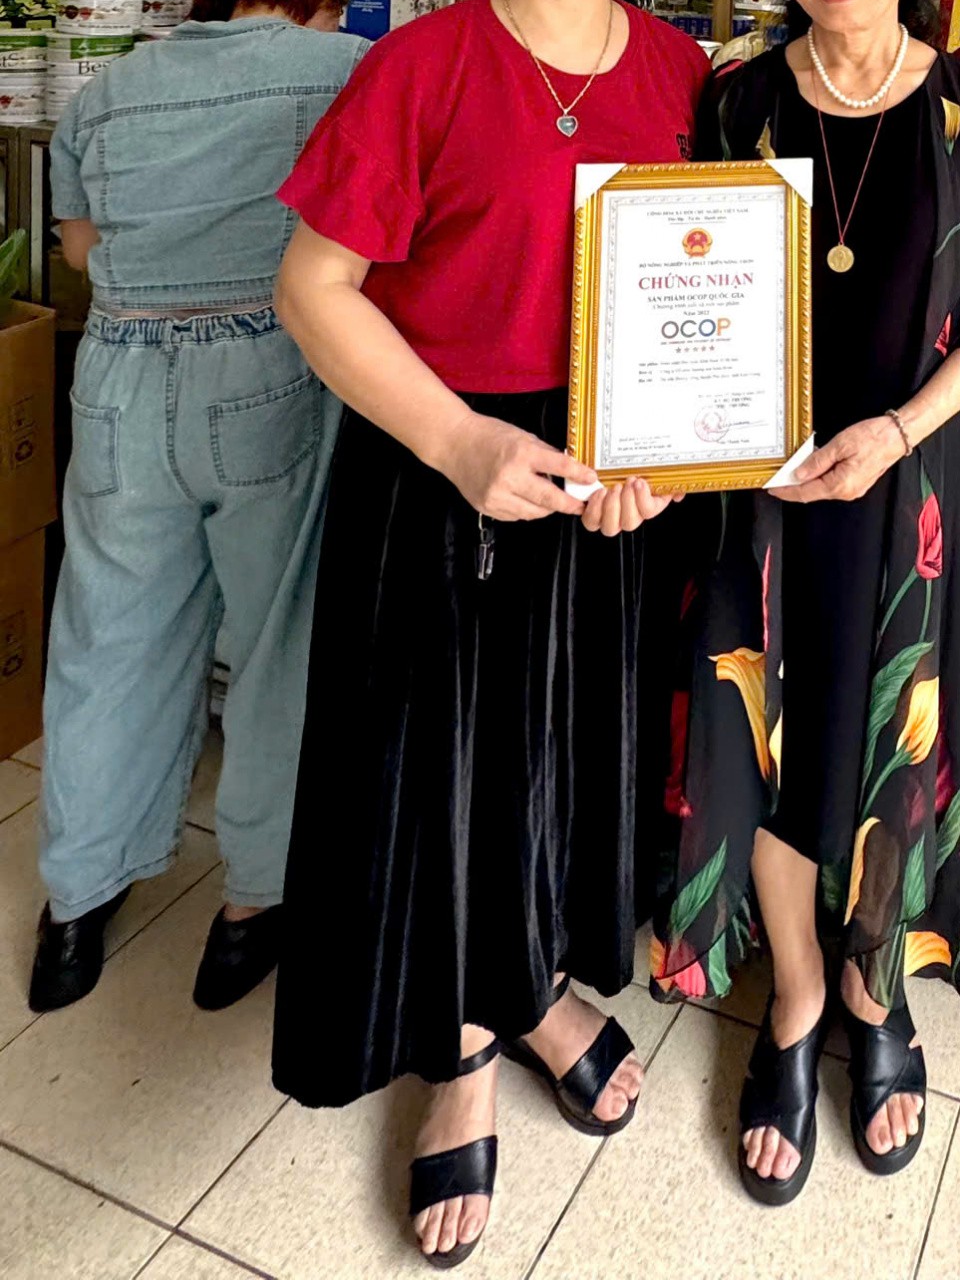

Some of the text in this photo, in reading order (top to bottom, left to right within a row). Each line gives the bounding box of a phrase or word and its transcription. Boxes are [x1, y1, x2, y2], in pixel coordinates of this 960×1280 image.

[638, 272, 754, 290] CHỨNG NHẬN
[661, 317, 731, 339] OCOP
